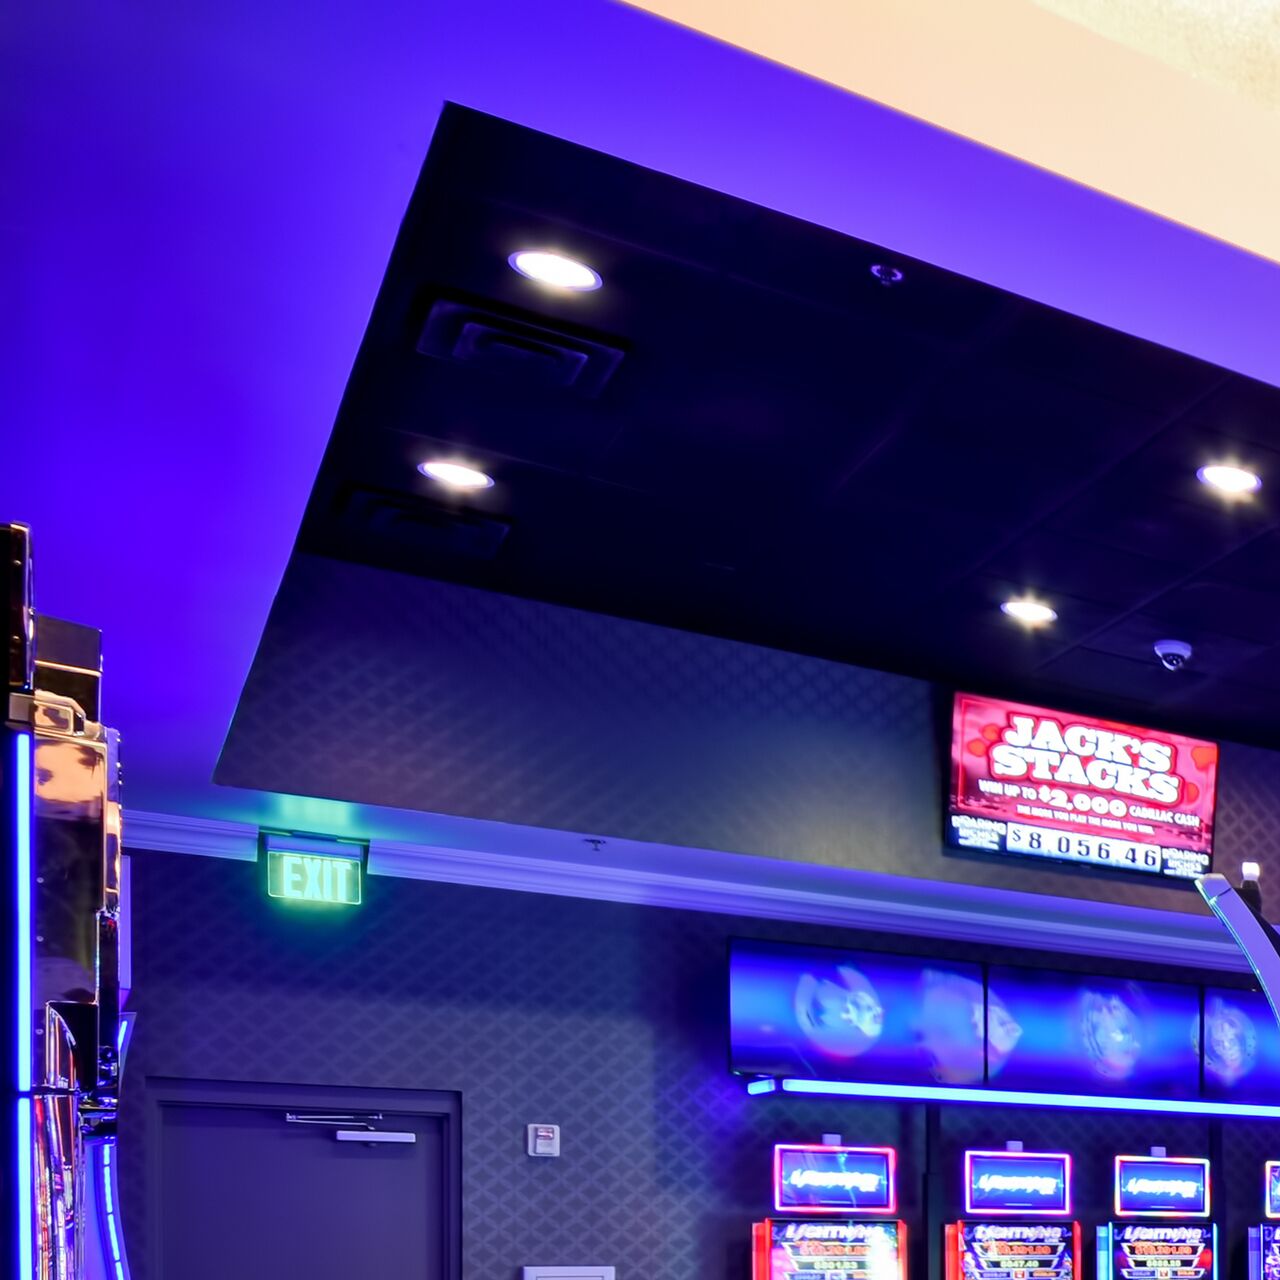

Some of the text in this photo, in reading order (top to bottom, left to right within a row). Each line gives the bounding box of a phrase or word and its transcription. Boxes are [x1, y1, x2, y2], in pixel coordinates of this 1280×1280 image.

[1002, 715, 1172, 773] JACK'S
[992, 746, 1179, 803] STACKS
[1038, 785, 1127, 817] $2,000
[283, 856, 353, 902] EXIT
